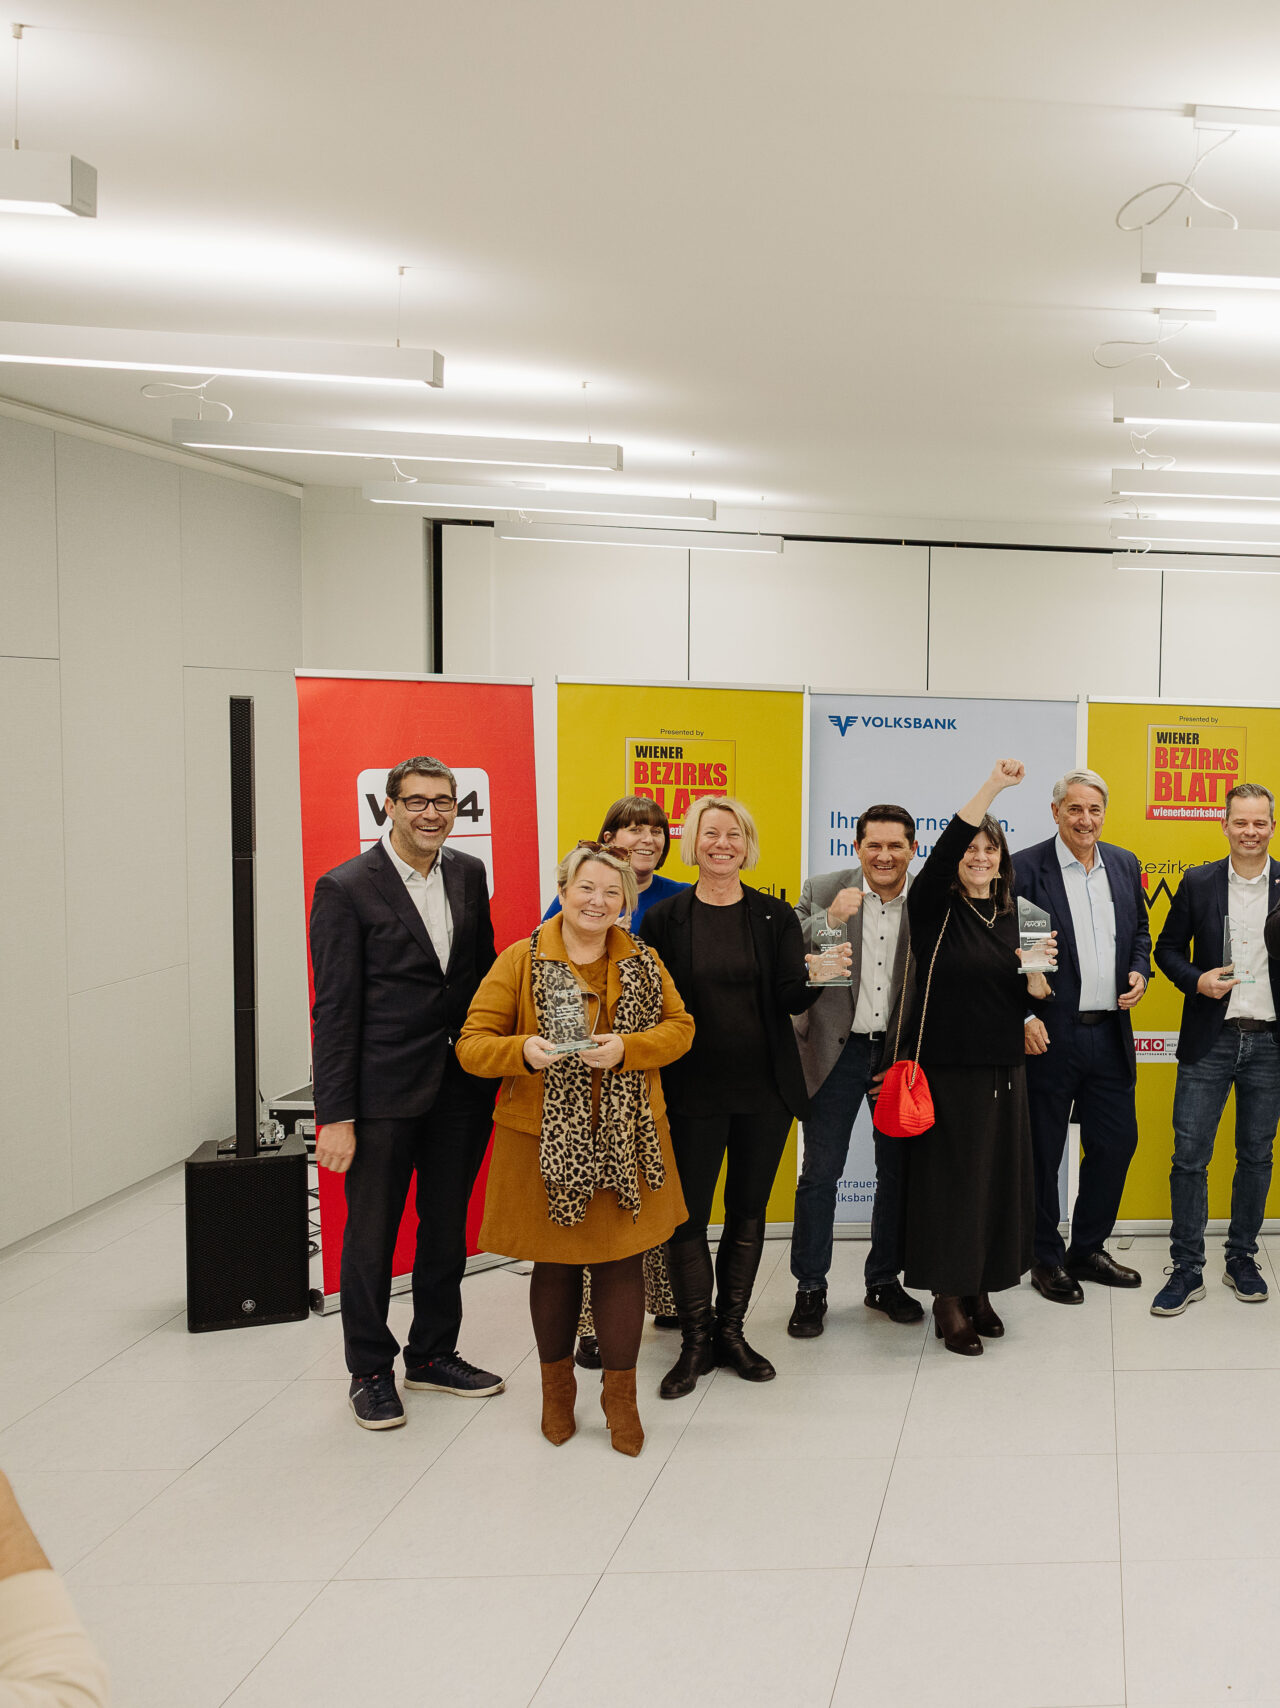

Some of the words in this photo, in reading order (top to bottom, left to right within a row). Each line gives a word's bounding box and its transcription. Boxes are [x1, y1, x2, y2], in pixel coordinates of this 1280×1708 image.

[861, 716, 958, 730] VOLKSBANK
[1179, 715, 1210, 723] Presented
[1210, 716, 1219, 724] by
[660, 728, 694, 736] Presented
[695, 729, 705, 737] by
[1156, 731, 1200, 745] WIENER
[635, 745, 684, 759] WIENER
[1154, 747, 1239, 771] BEZIRKS
[634, 761, 728, 786] BEZIRKS
[1154, 771, 1239, 803] BLATT
